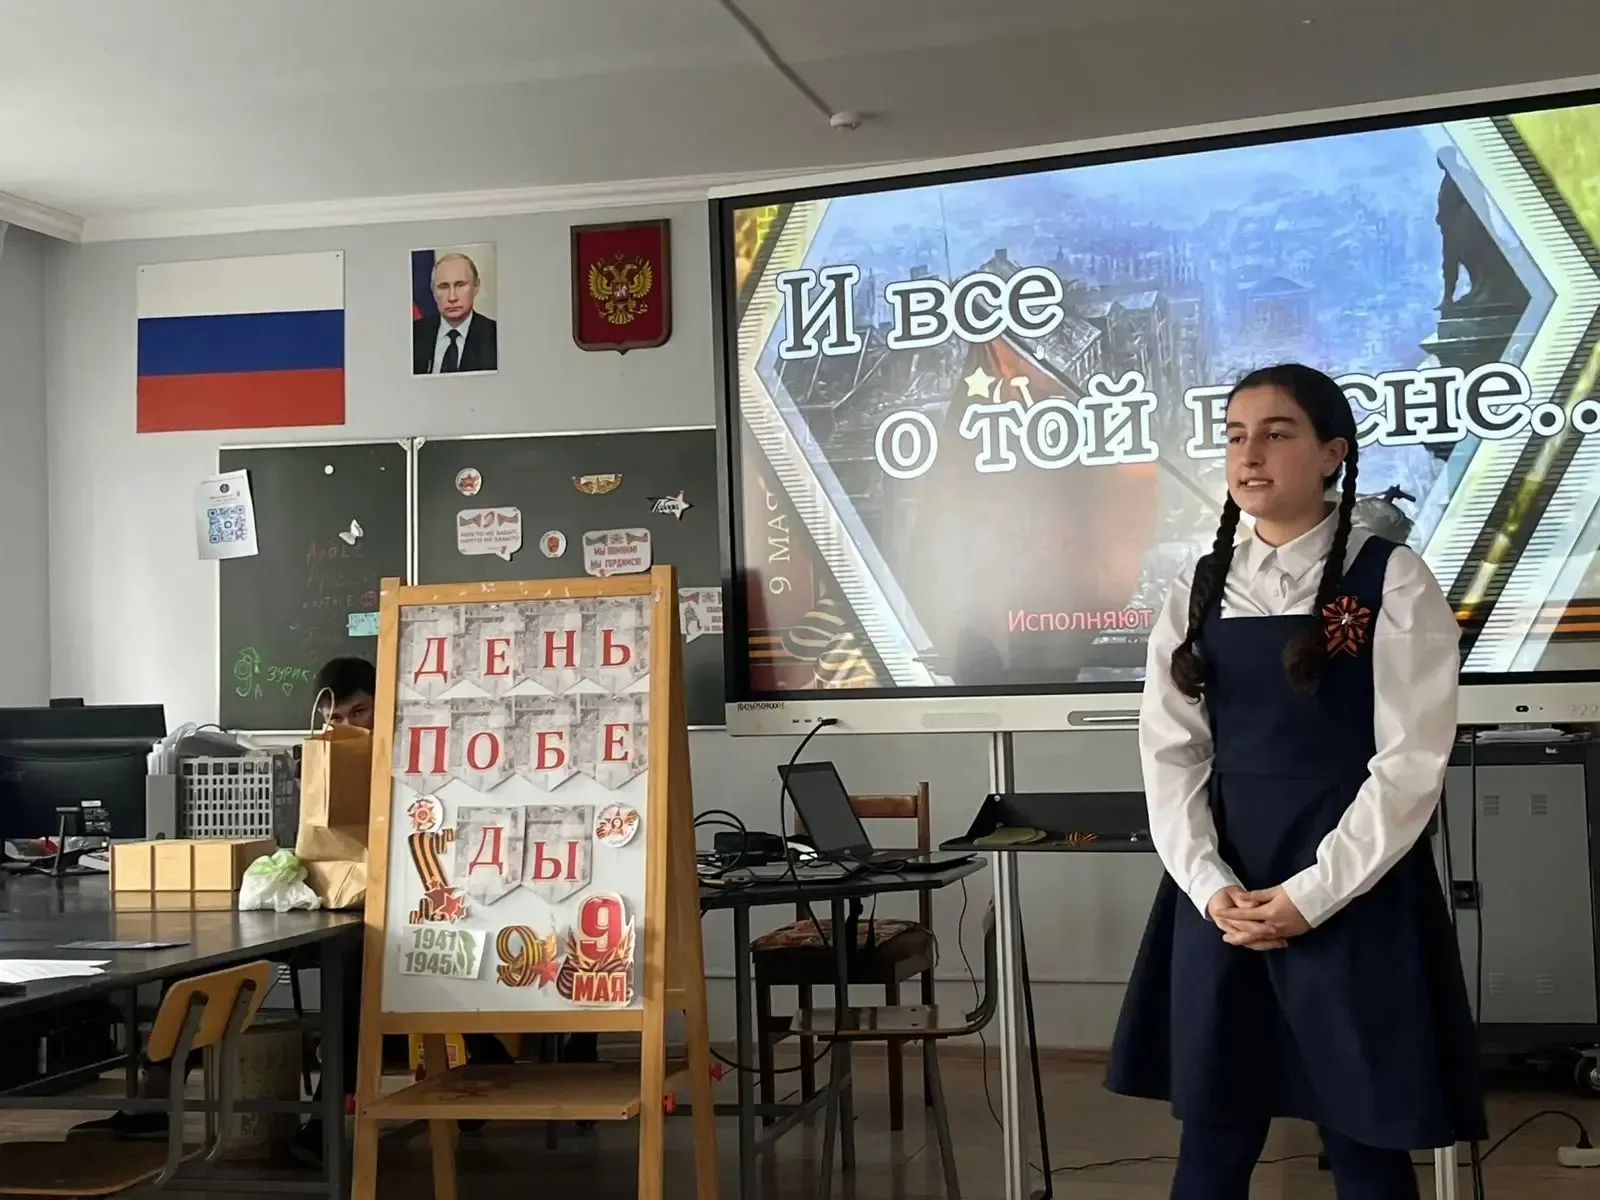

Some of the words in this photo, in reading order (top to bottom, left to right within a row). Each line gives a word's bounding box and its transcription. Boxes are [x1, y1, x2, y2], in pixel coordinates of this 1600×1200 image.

[776, 265, 862, 360] И
[885, 266, 1065, 350] все
[875, 410, 938, 479] о
[959, 371, 1159, 473] той
[769, 576, 792, 595] 9
[1008, 607, 1153, 633] Исполняют
[413, 628, 632, 684] ДЕНЬ
[404, 722, 630, 774] ПОБЕ
[468, 826, 580, 881] ДЫ
[413, 927, 456, 951] 1941
[579, 897, 623, 961] 9
[405, 951, 453, 975] 1945
[574, 973, 627, 1003] МАЯ
